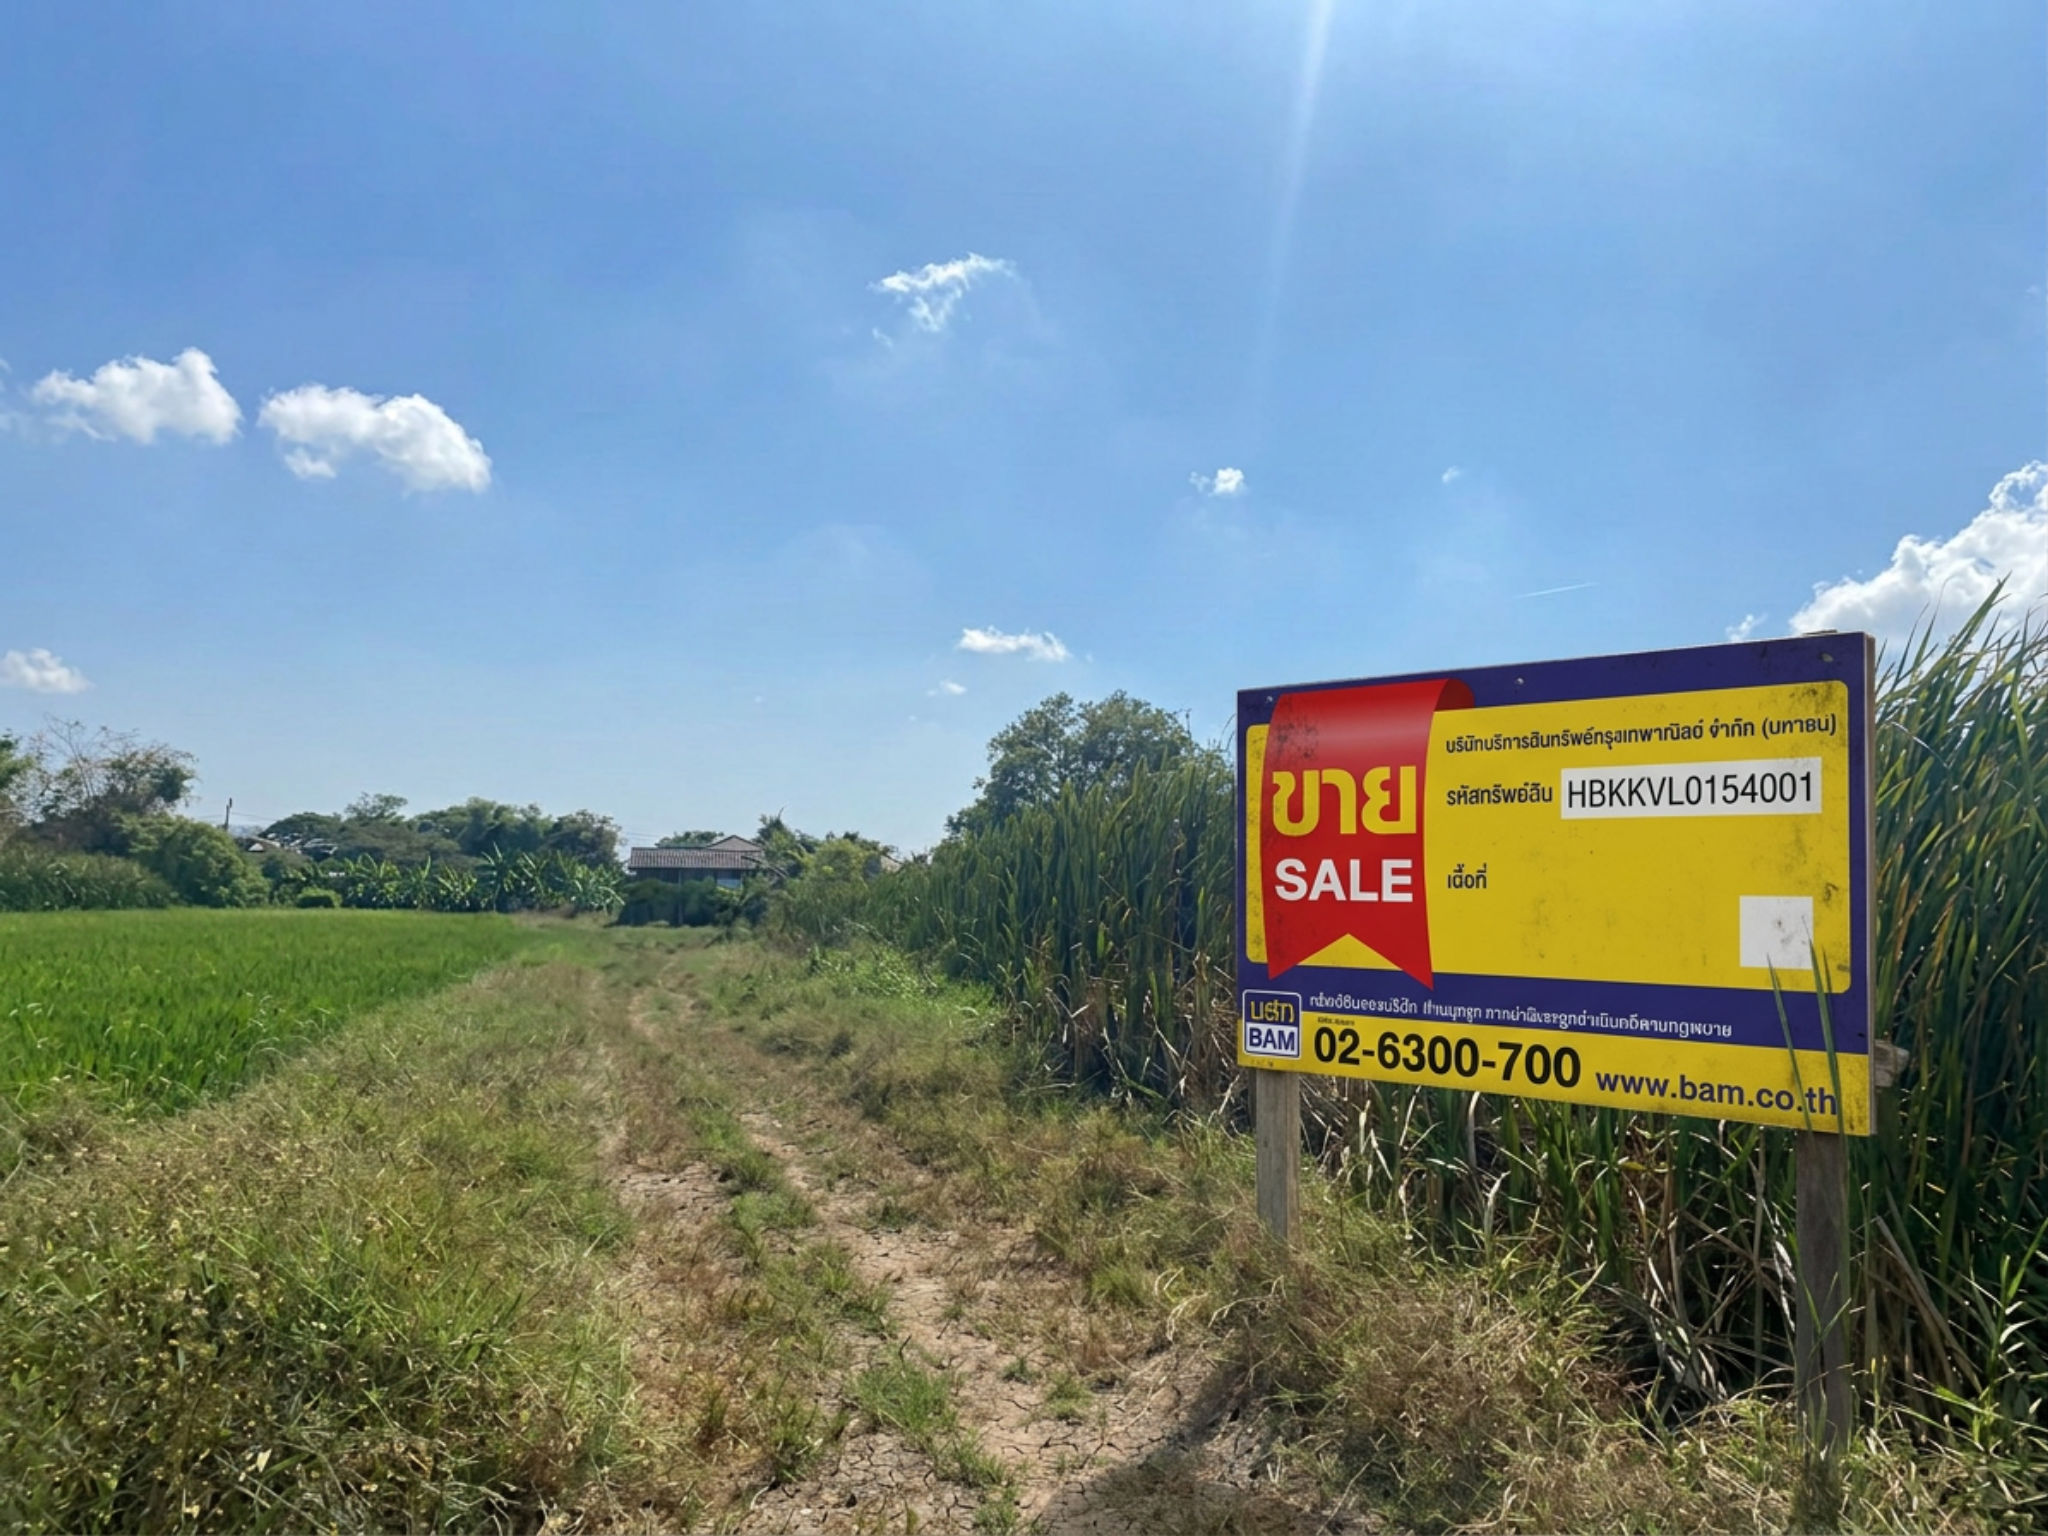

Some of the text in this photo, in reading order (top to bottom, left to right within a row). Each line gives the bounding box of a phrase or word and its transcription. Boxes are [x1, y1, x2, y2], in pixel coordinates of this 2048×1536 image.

[1271, 765, 1417, 837] ขาย
[1567, 770, 1812, 809] HBKKVL0154001
[1274, 857, 1414, 903] SALE
[1248, 1026, 1296, 1052] BAM
[1313, 1026, 1582, 1089] 02-6300-700
[1595, 1071, 1838, 1116] www.bam.co.th
